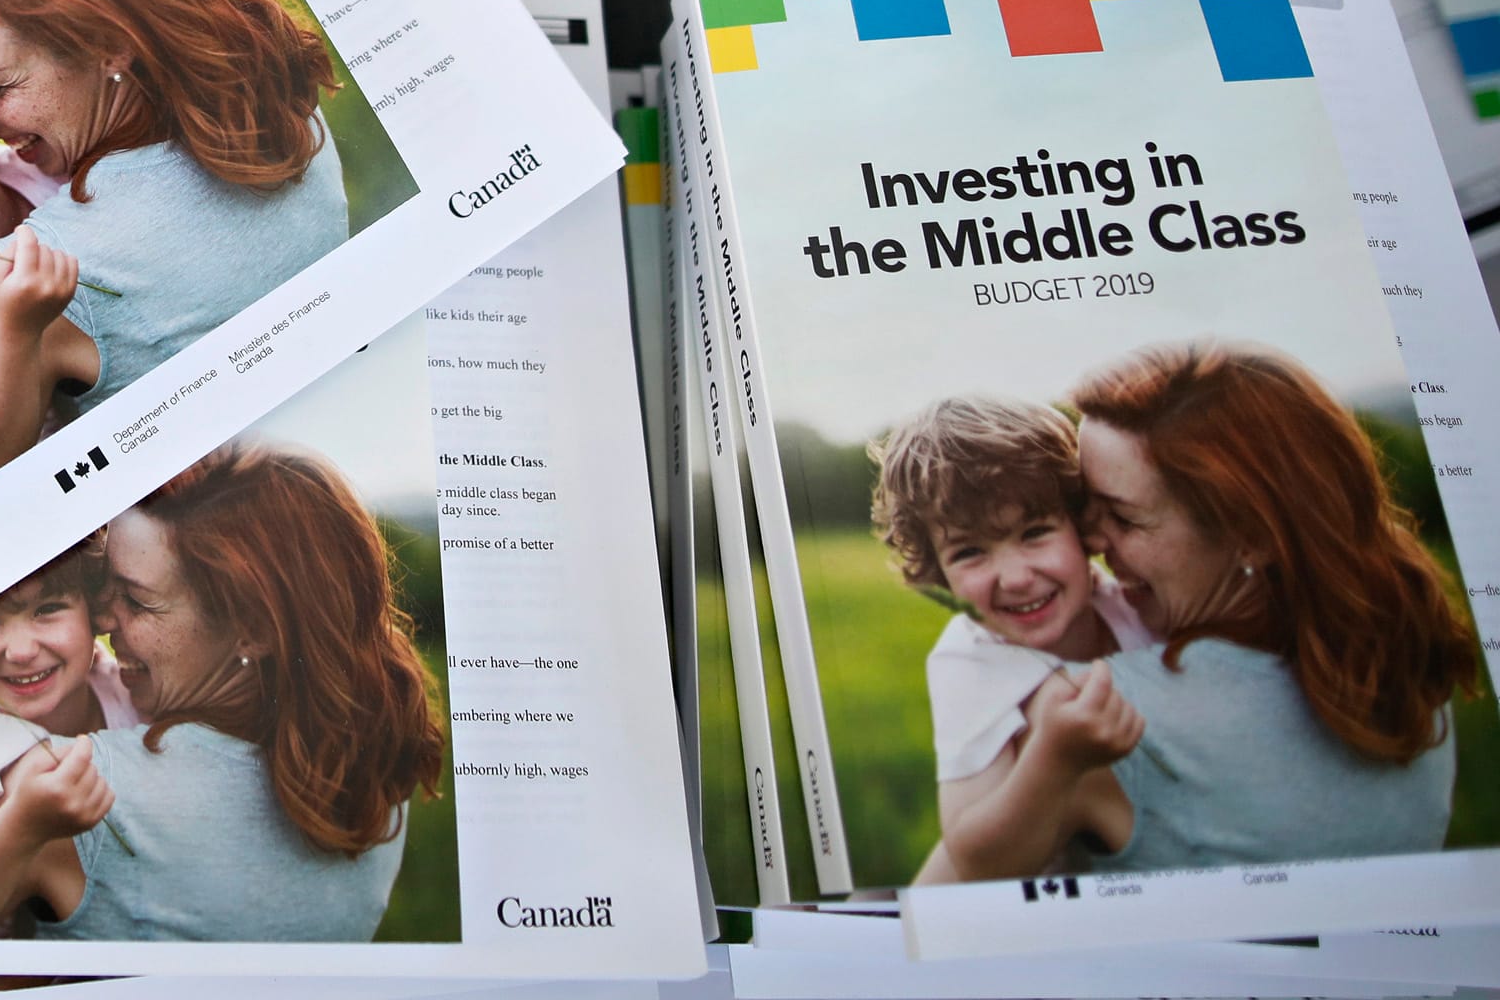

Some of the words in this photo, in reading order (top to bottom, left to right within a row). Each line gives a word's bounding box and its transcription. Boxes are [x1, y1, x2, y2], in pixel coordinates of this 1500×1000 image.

[371, 29, 402, 54] where
[402, 19, 419, 33] we
[396, 75, 425, 96] high,
[424, 53, 455, 79] wages
[670, 60, 689, 184] Investing
[447, 143, 542, 218] Canada
[861, 148, 1135, 209] Investing
[1144, 141, 1204, 188] in
[686, 188, 693, 215] in
[1369, 191, 1398, 205] people
[682, 17, 708, 145] Investing
[705, 150, 714, 178] in
[711, 183, 723, 231] the
[721, 238, 742, 341] Middle
[740, 349, 757, 427] Class
[803, 225, 908, 279] the
[921, 207, 1134, 270] Middle
[1148, 200, 1307, 253] Class
[689, 220, 699, 266] the
[506, 266, 544, 279] people
[973, 276, 1085, 306] BUDGET
[1094, 271, 1155, 299] 2019
[228, 332, 271, 365] Ministère
[270, 318, 289, 335] des
[288, 289, 331, 324] Finances
[426, 308, 448, 320] like
[450, 309, 474, 322] kids
[477, 310, 504, 323] their
[507, 313, 528, 325] age
[696, 274, 713, 373] Middle
[236, 345, 274, 375] Canada
[112, 401, 170, 445] Department
[170, 392, 182, 406] of
[179, 368, 217, 398] Finance
[709, 381, 722, 457] Class
[1434, 414, 1463, 429] began
[120, 424, 160, 455] Canada
[439, 453, 459, 467] the
[462, 454, 507, 468] Middle
[510, 455, 547, 469] Class.
[1445, 464, 1473, 476] better
[445, 486, 487, 500] middle
[489, 487, 518, 500] class
[521, 488, 556, 503] began
[549, 765, 589, 778] wages
[754, 767, 774, 869] Canada
[807, 749, 831, 856] Canada
[1243, 870, 1289, 885] Canada
[497, 897, 615, 928] Canada
